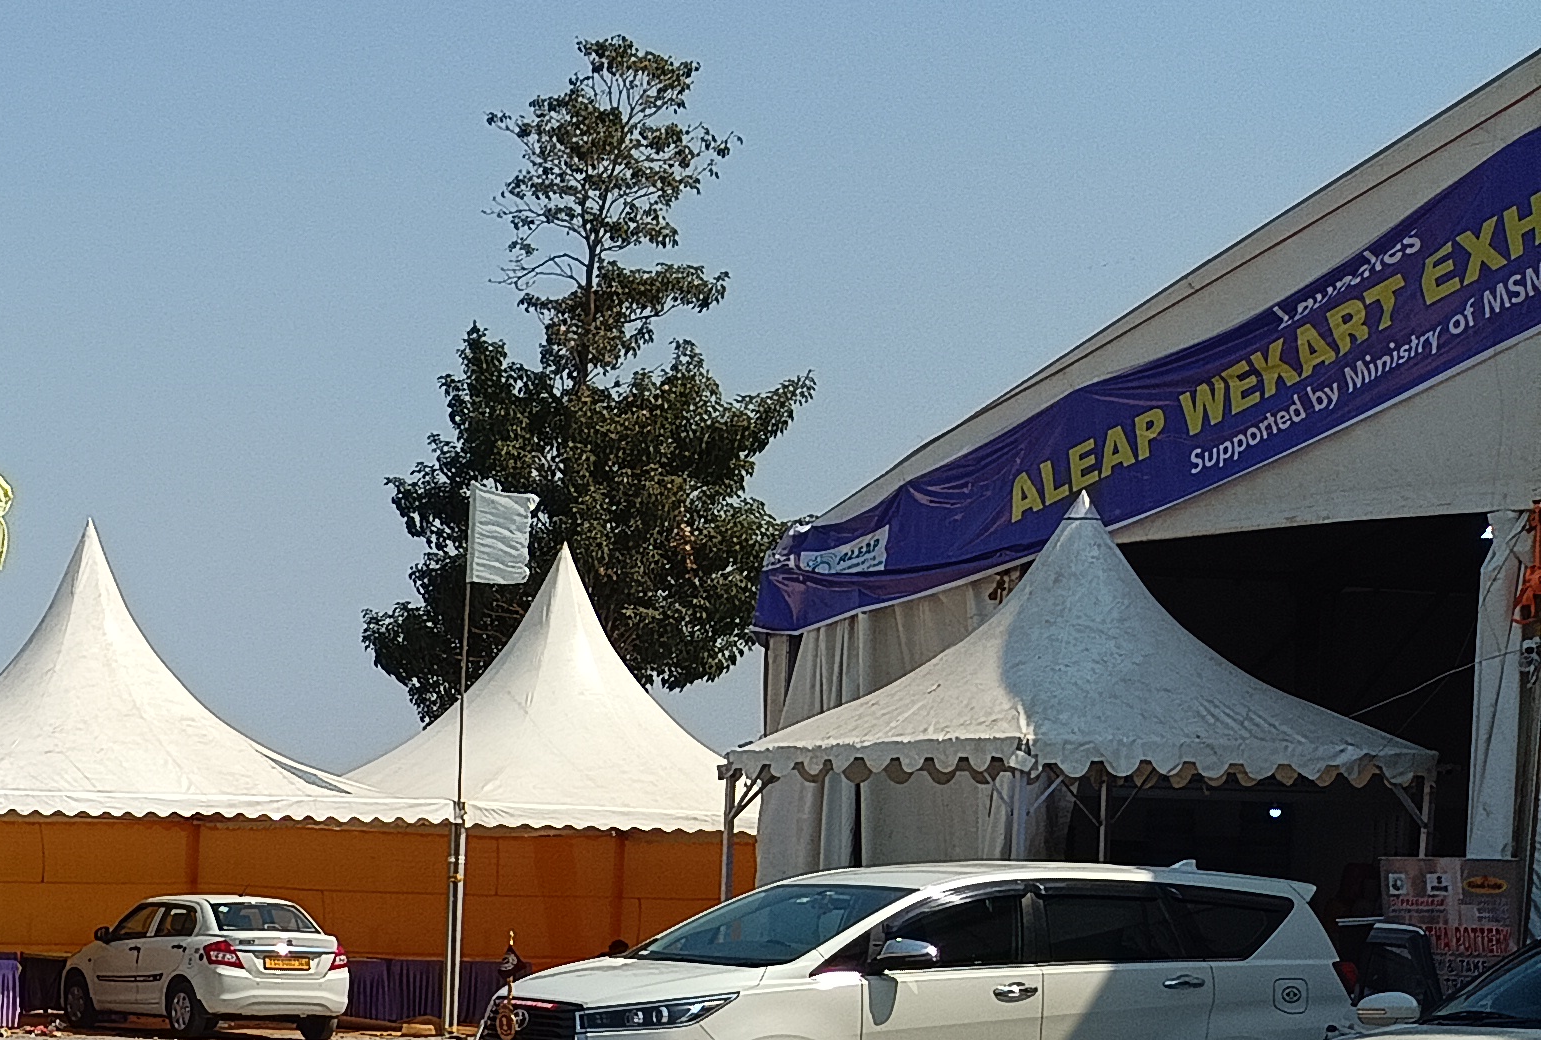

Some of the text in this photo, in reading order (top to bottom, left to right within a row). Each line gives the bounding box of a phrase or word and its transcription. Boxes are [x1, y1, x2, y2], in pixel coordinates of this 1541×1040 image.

[1011, 408, 1165, 523] ALEAP
[1179, 274, 1405, 436] WEKART
[1190, 394, 1306, 474] Supported
[1306, 382, 1339, 412] by
[1344, 325, 1443, 393] Ministry
[1448, 298, 1476, 335] of
[837, 538, 880, 565] ALEAP
[1455, 926, 1511, 955] POTTERY
